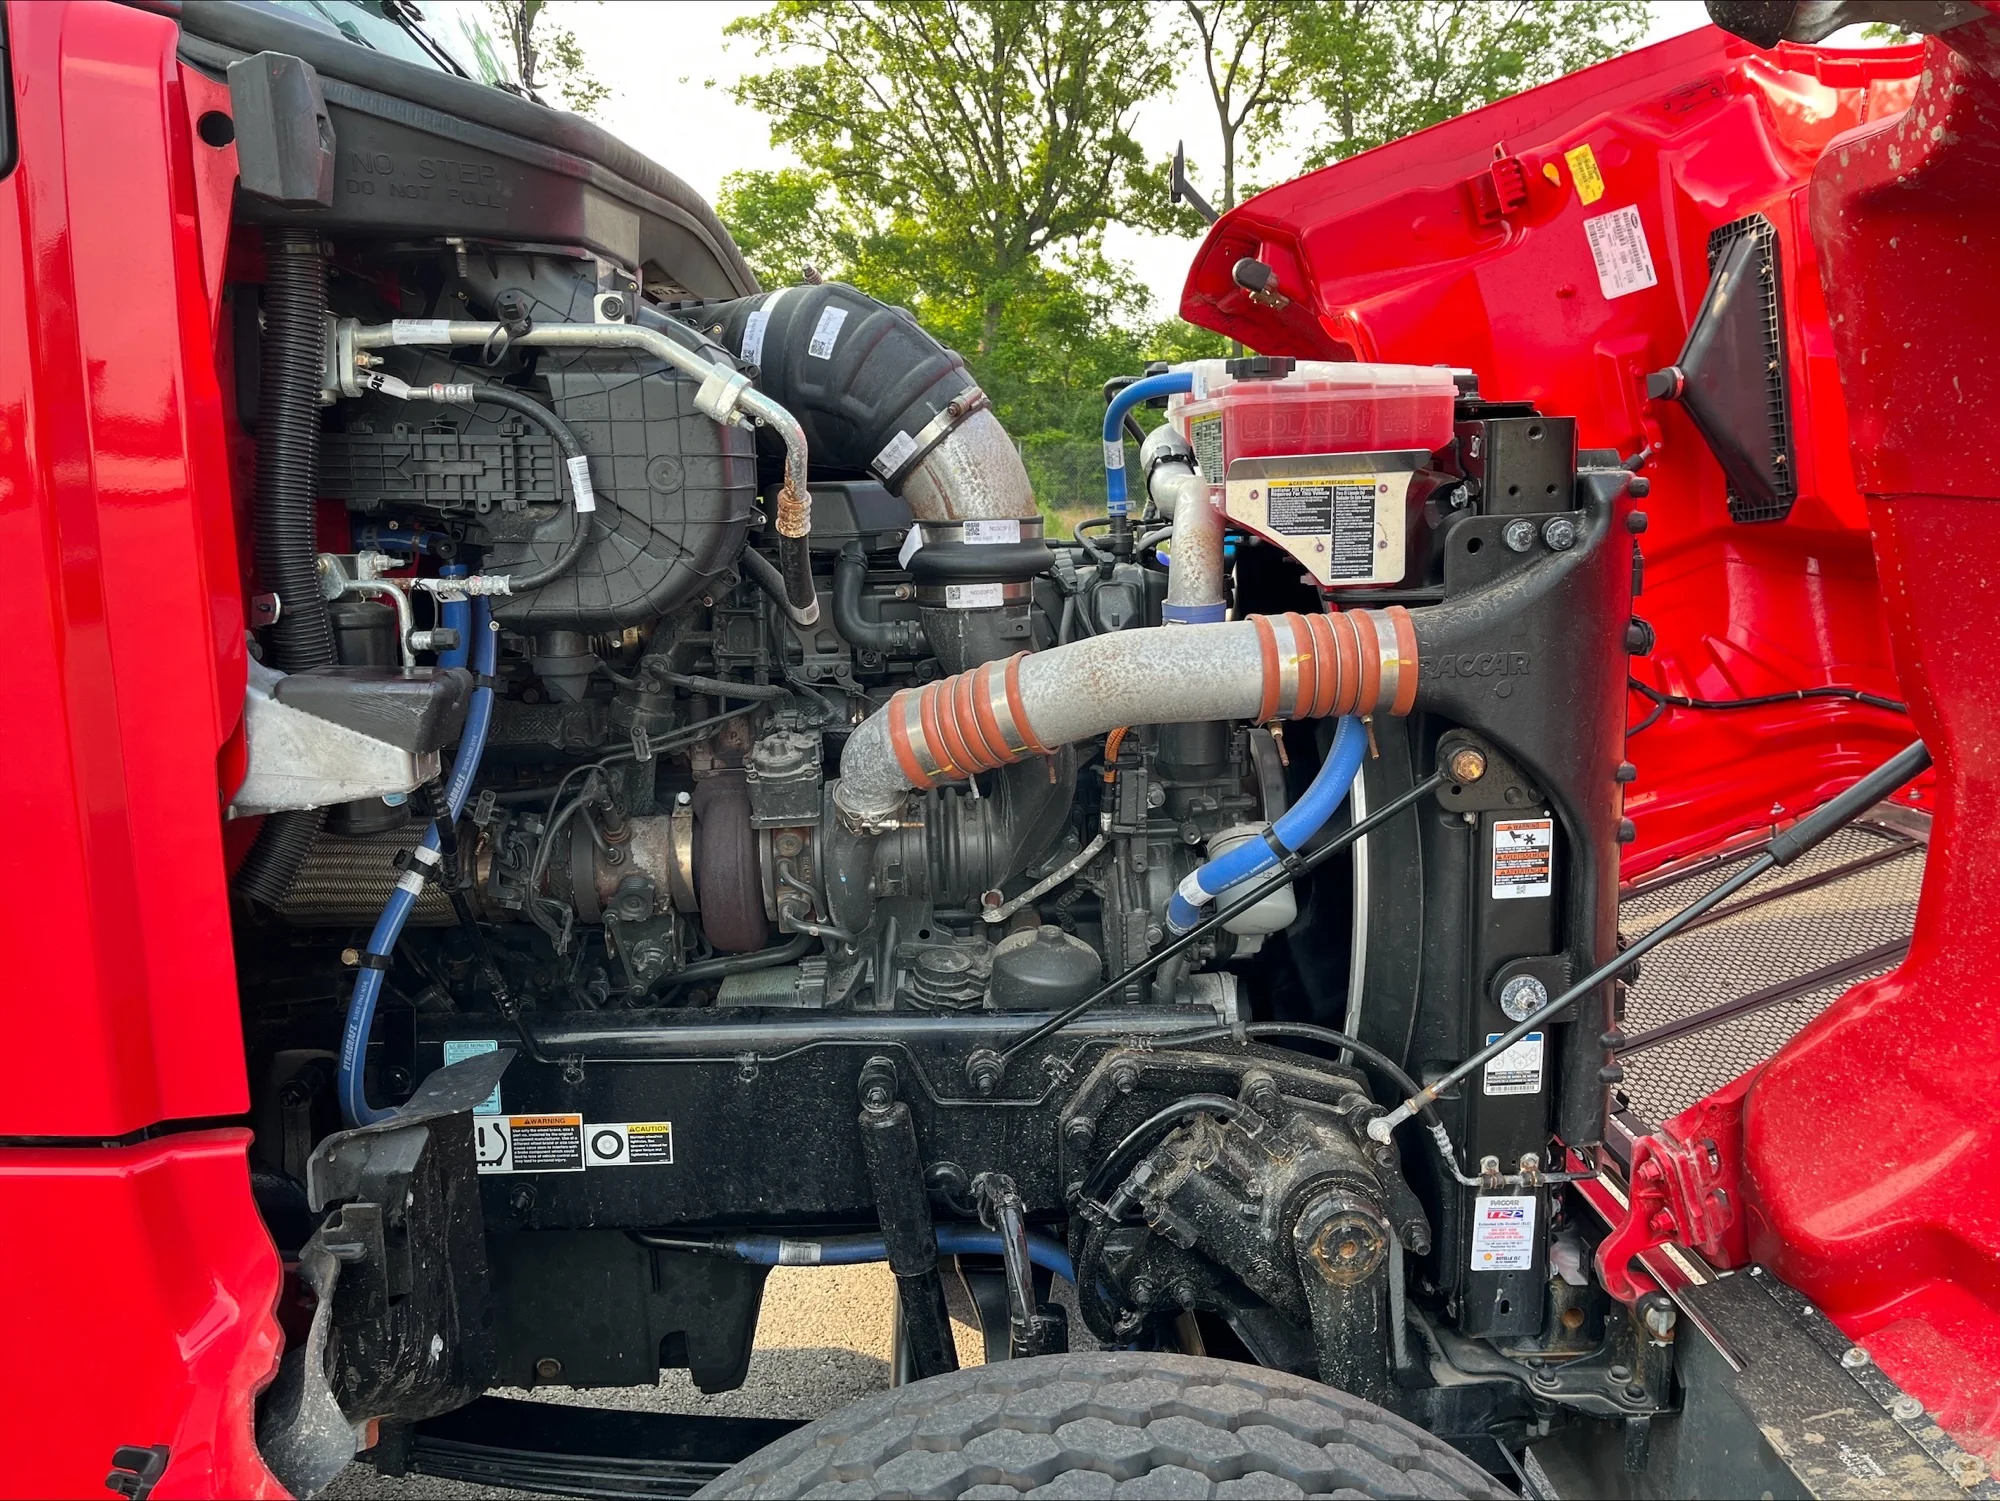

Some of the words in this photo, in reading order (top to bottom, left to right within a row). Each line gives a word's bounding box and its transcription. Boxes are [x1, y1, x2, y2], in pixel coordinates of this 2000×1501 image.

[353, 152, 394, 175] NO
[418, 158, 496, 185] STEP
[346, 179, 375, 195] DO
[390, 182, 431, 200] NOT
[448, 188, 501, 208] PULL
[1488, 1210, 1524, 1219] TRP
